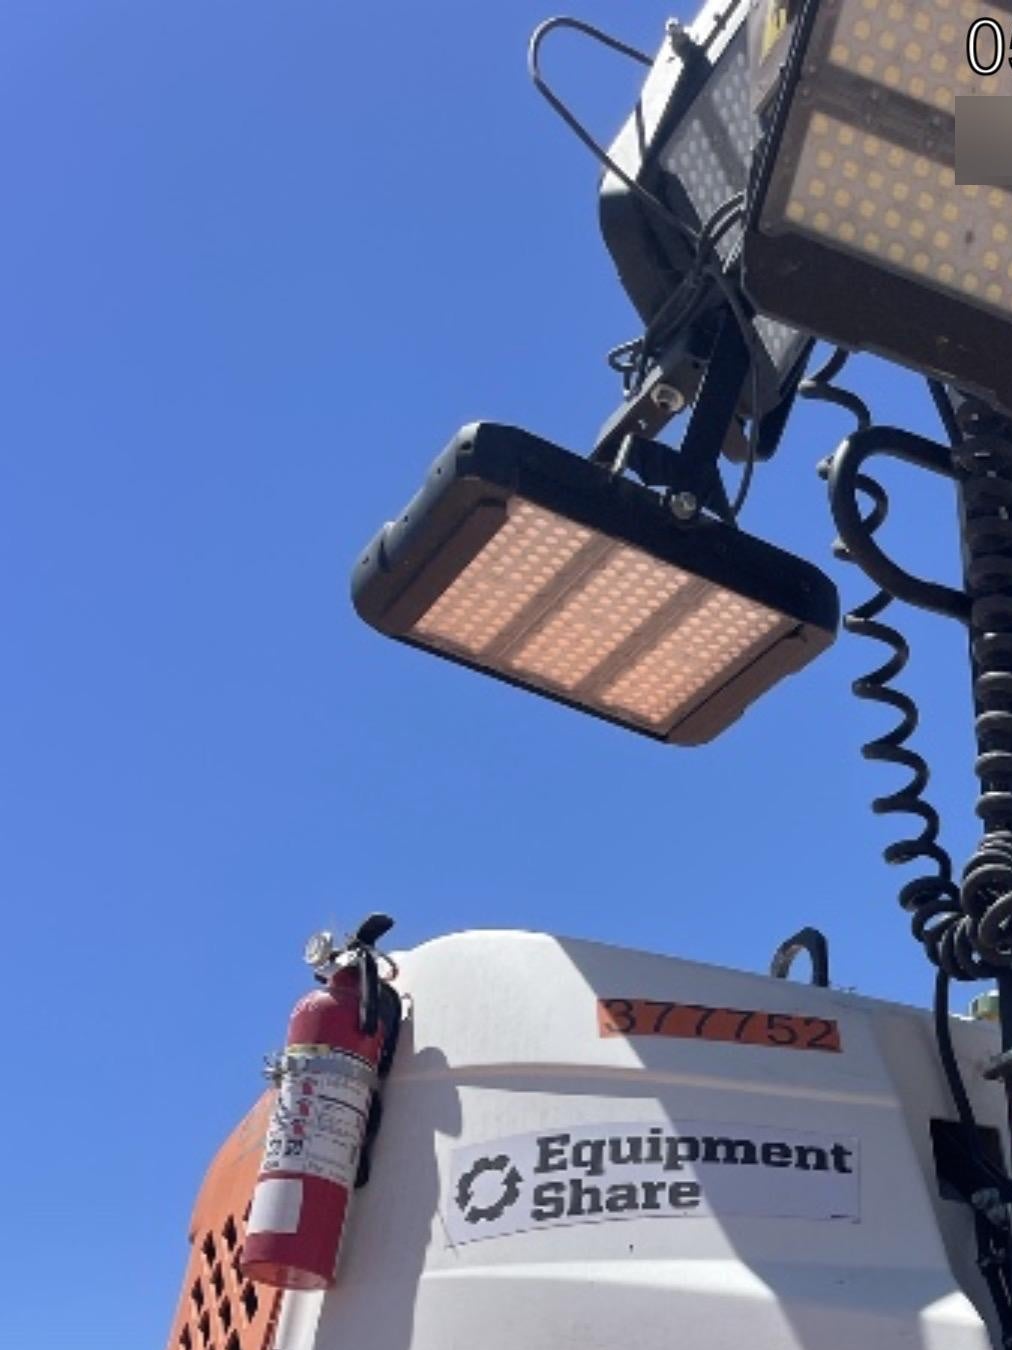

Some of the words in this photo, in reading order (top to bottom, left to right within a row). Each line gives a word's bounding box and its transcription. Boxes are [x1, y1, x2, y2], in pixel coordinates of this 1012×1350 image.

[604, 999, 839, 1051] 377752
[533, 1127, 852, 1175] Equipment
[531, 1177, 701, 1221] Share
